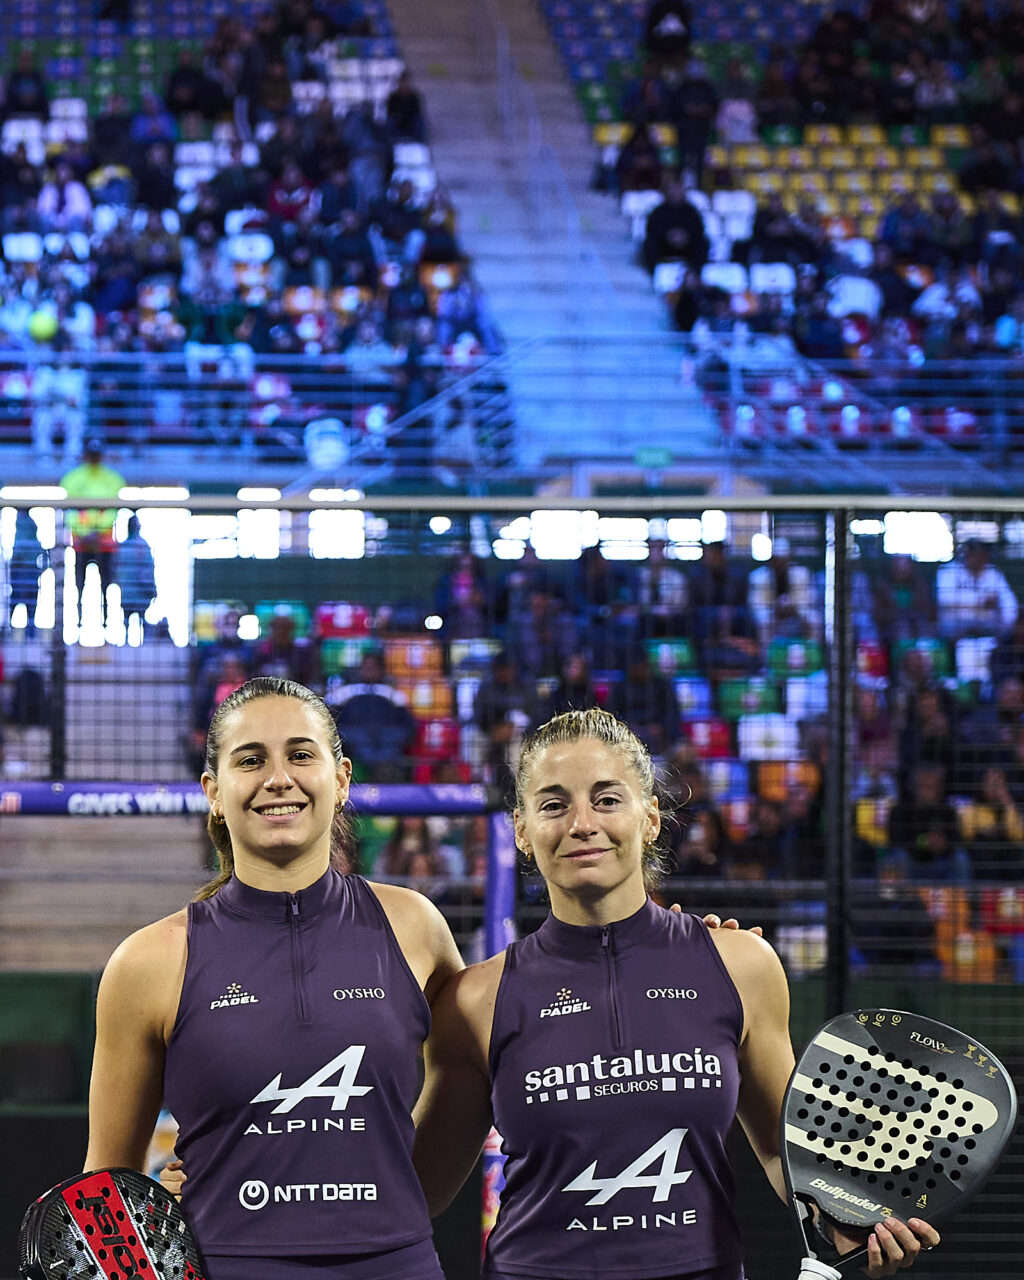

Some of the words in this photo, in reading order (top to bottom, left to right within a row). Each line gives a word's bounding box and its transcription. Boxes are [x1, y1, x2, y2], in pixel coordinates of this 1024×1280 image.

[333, 987, 386, 1000] OYSHO
[646, 988, 698, 1000] OYSHO
[210, 995, 259, 1010] PADEL
[539, 1001, 592, 1018] PADEL
[525, 1047, 722, 1092] santalucía
[593, 1079, 659, 1097] SEGUROS
[243, 1118, 366, 1135] ALPINE
[274, 1184, 320, 1202] NTT
[809, 1178, 882, 1212] Bullpadel
[566, 1209, 697, 1231] ALPINE
